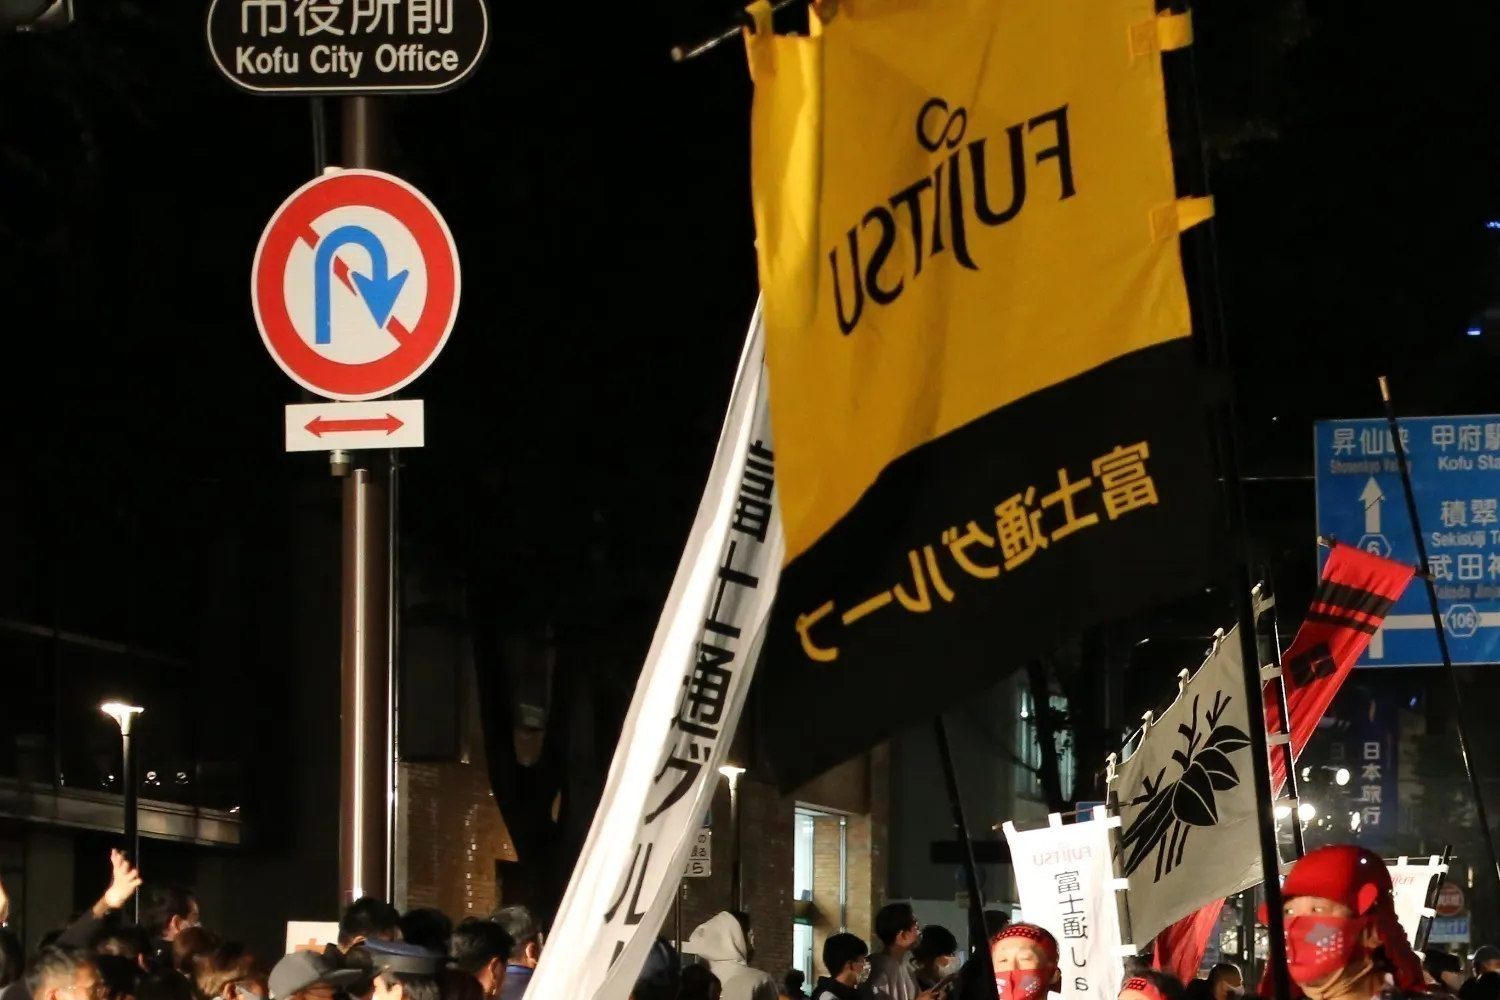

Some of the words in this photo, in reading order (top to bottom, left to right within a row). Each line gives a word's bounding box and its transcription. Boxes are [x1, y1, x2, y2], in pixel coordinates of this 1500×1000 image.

[235, 46, 299, 74] Kofu
[310, 44, 363, 78] City
[375, 43, 459, 73] Office
[1438, 455, 1473, 471] Kofu
[1450, 612, 1475, 629] 106
[1361, 741, 1382, 825] 日本旅行
